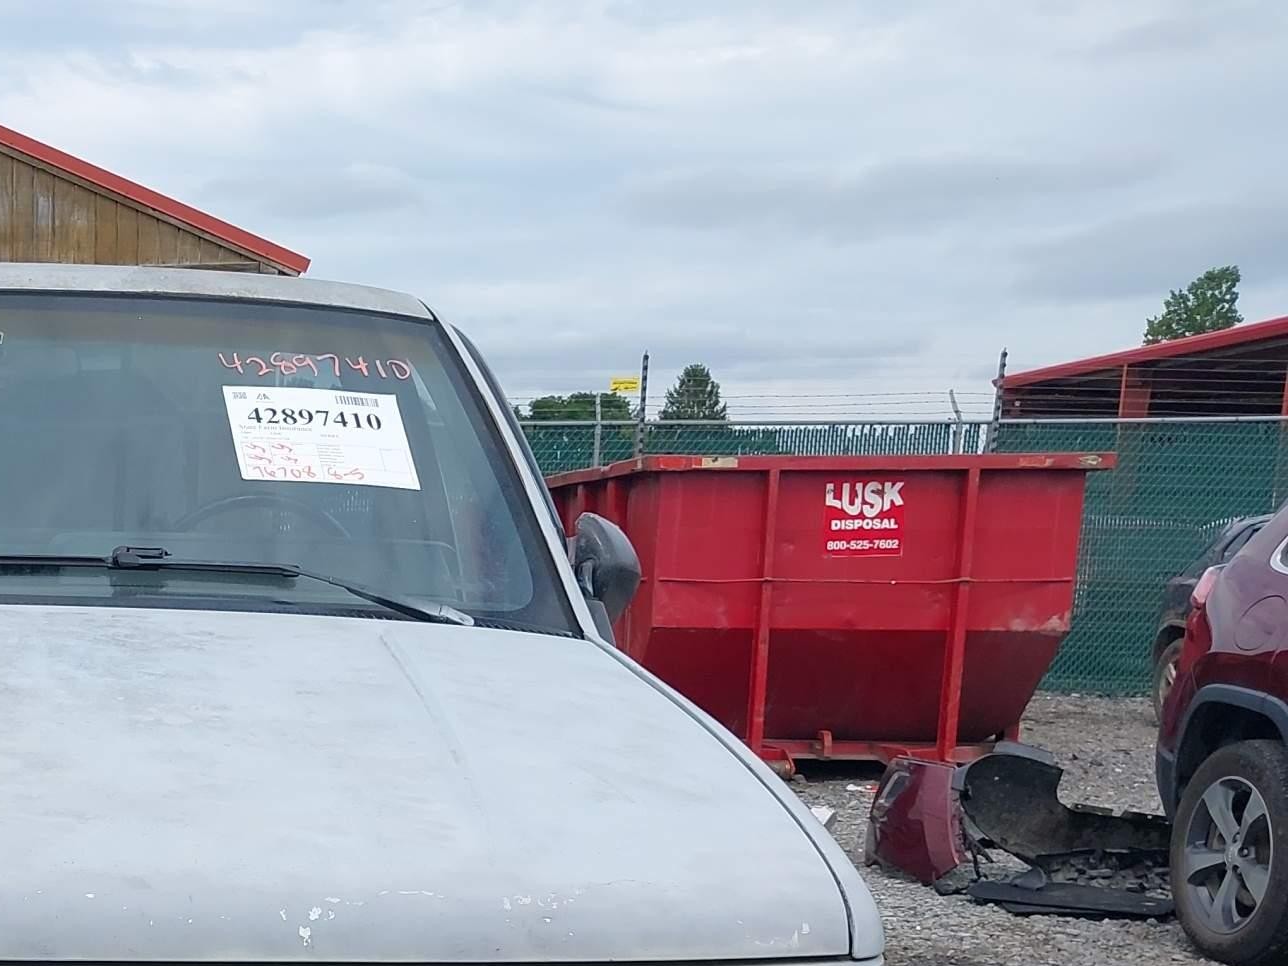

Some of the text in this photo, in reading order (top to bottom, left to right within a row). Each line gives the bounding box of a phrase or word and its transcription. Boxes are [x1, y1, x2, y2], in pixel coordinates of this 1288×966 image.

[218, 352, 411, 380] 42897410
[248, 407, 382, 431] 42897410
[825, 481, 904, 517] LUSK
[830, 518, 898, 531] DISPOSAL
[826, 539, 899, 550] 800-525-7602
